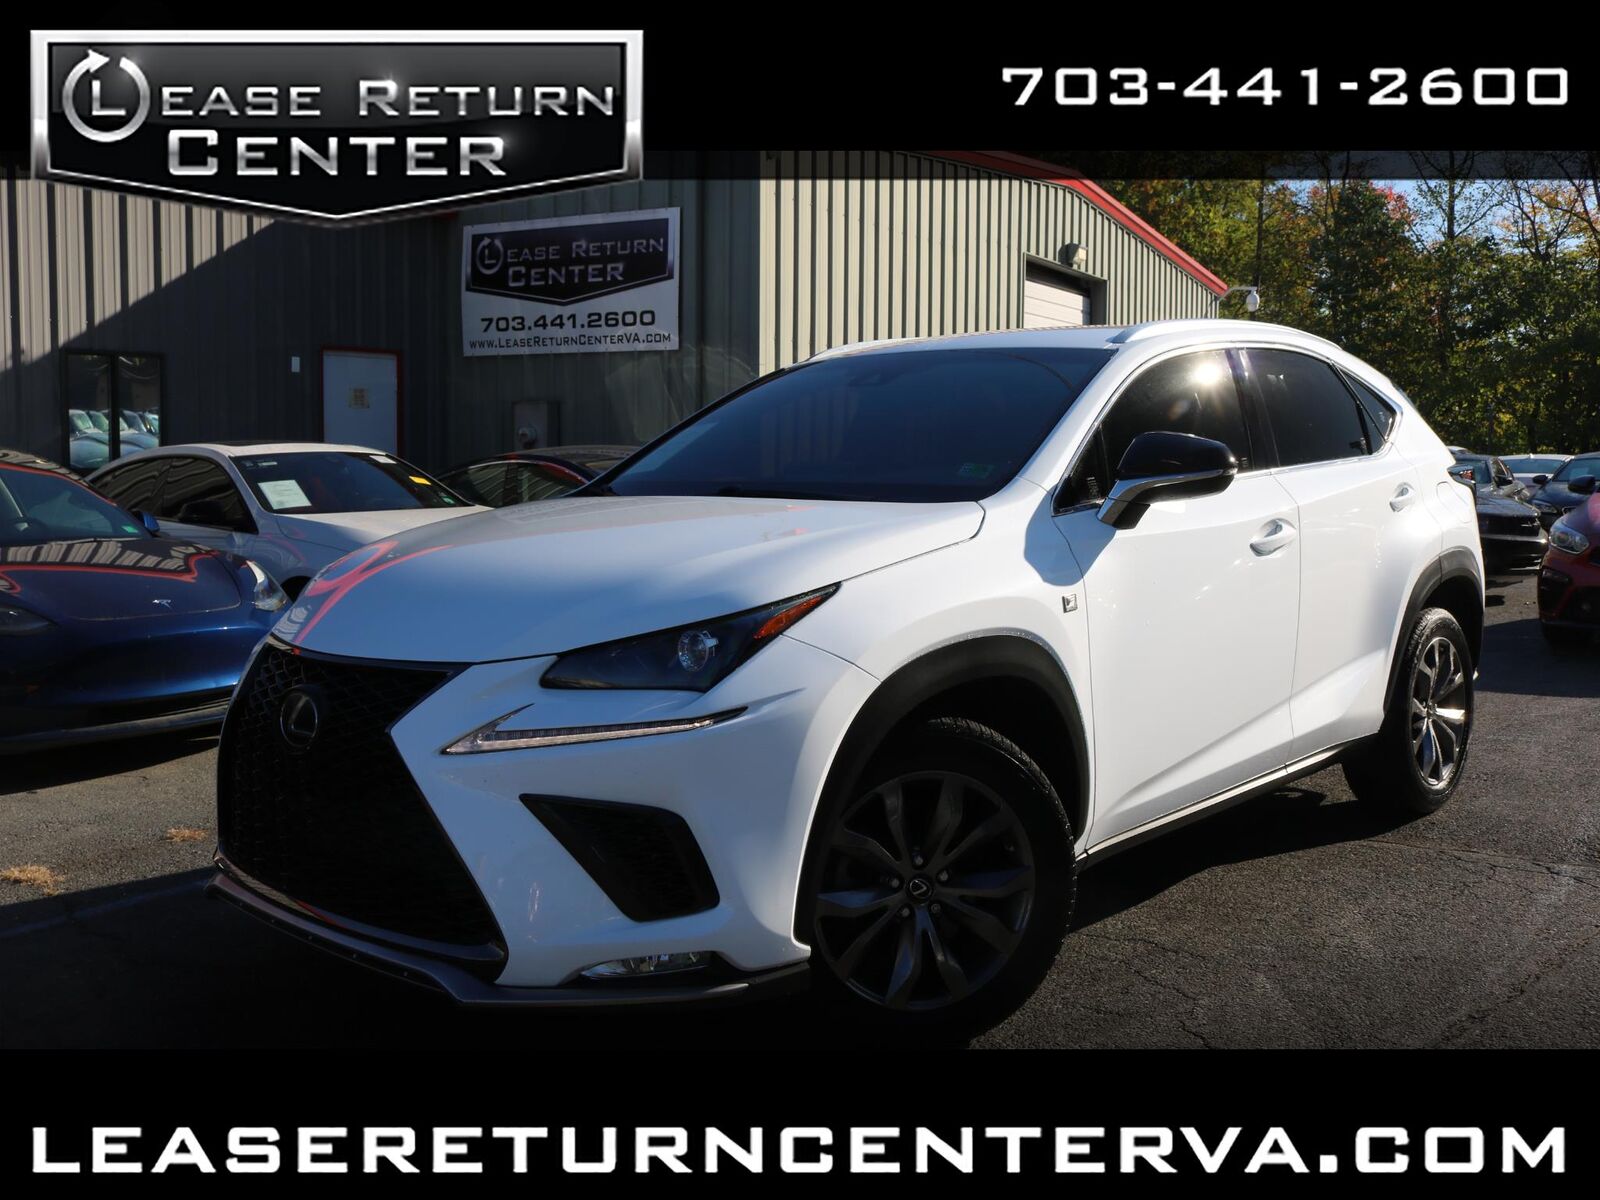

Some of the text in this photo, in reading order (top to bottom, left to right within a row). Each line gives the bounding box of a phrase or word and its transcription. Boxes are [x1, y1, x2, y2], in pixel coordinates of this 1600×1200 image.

[572, 237, 664, 258] RETURN
[508, 262, 625, 287] CENTER
[481, 310, 656, 333] 703.441.2600
